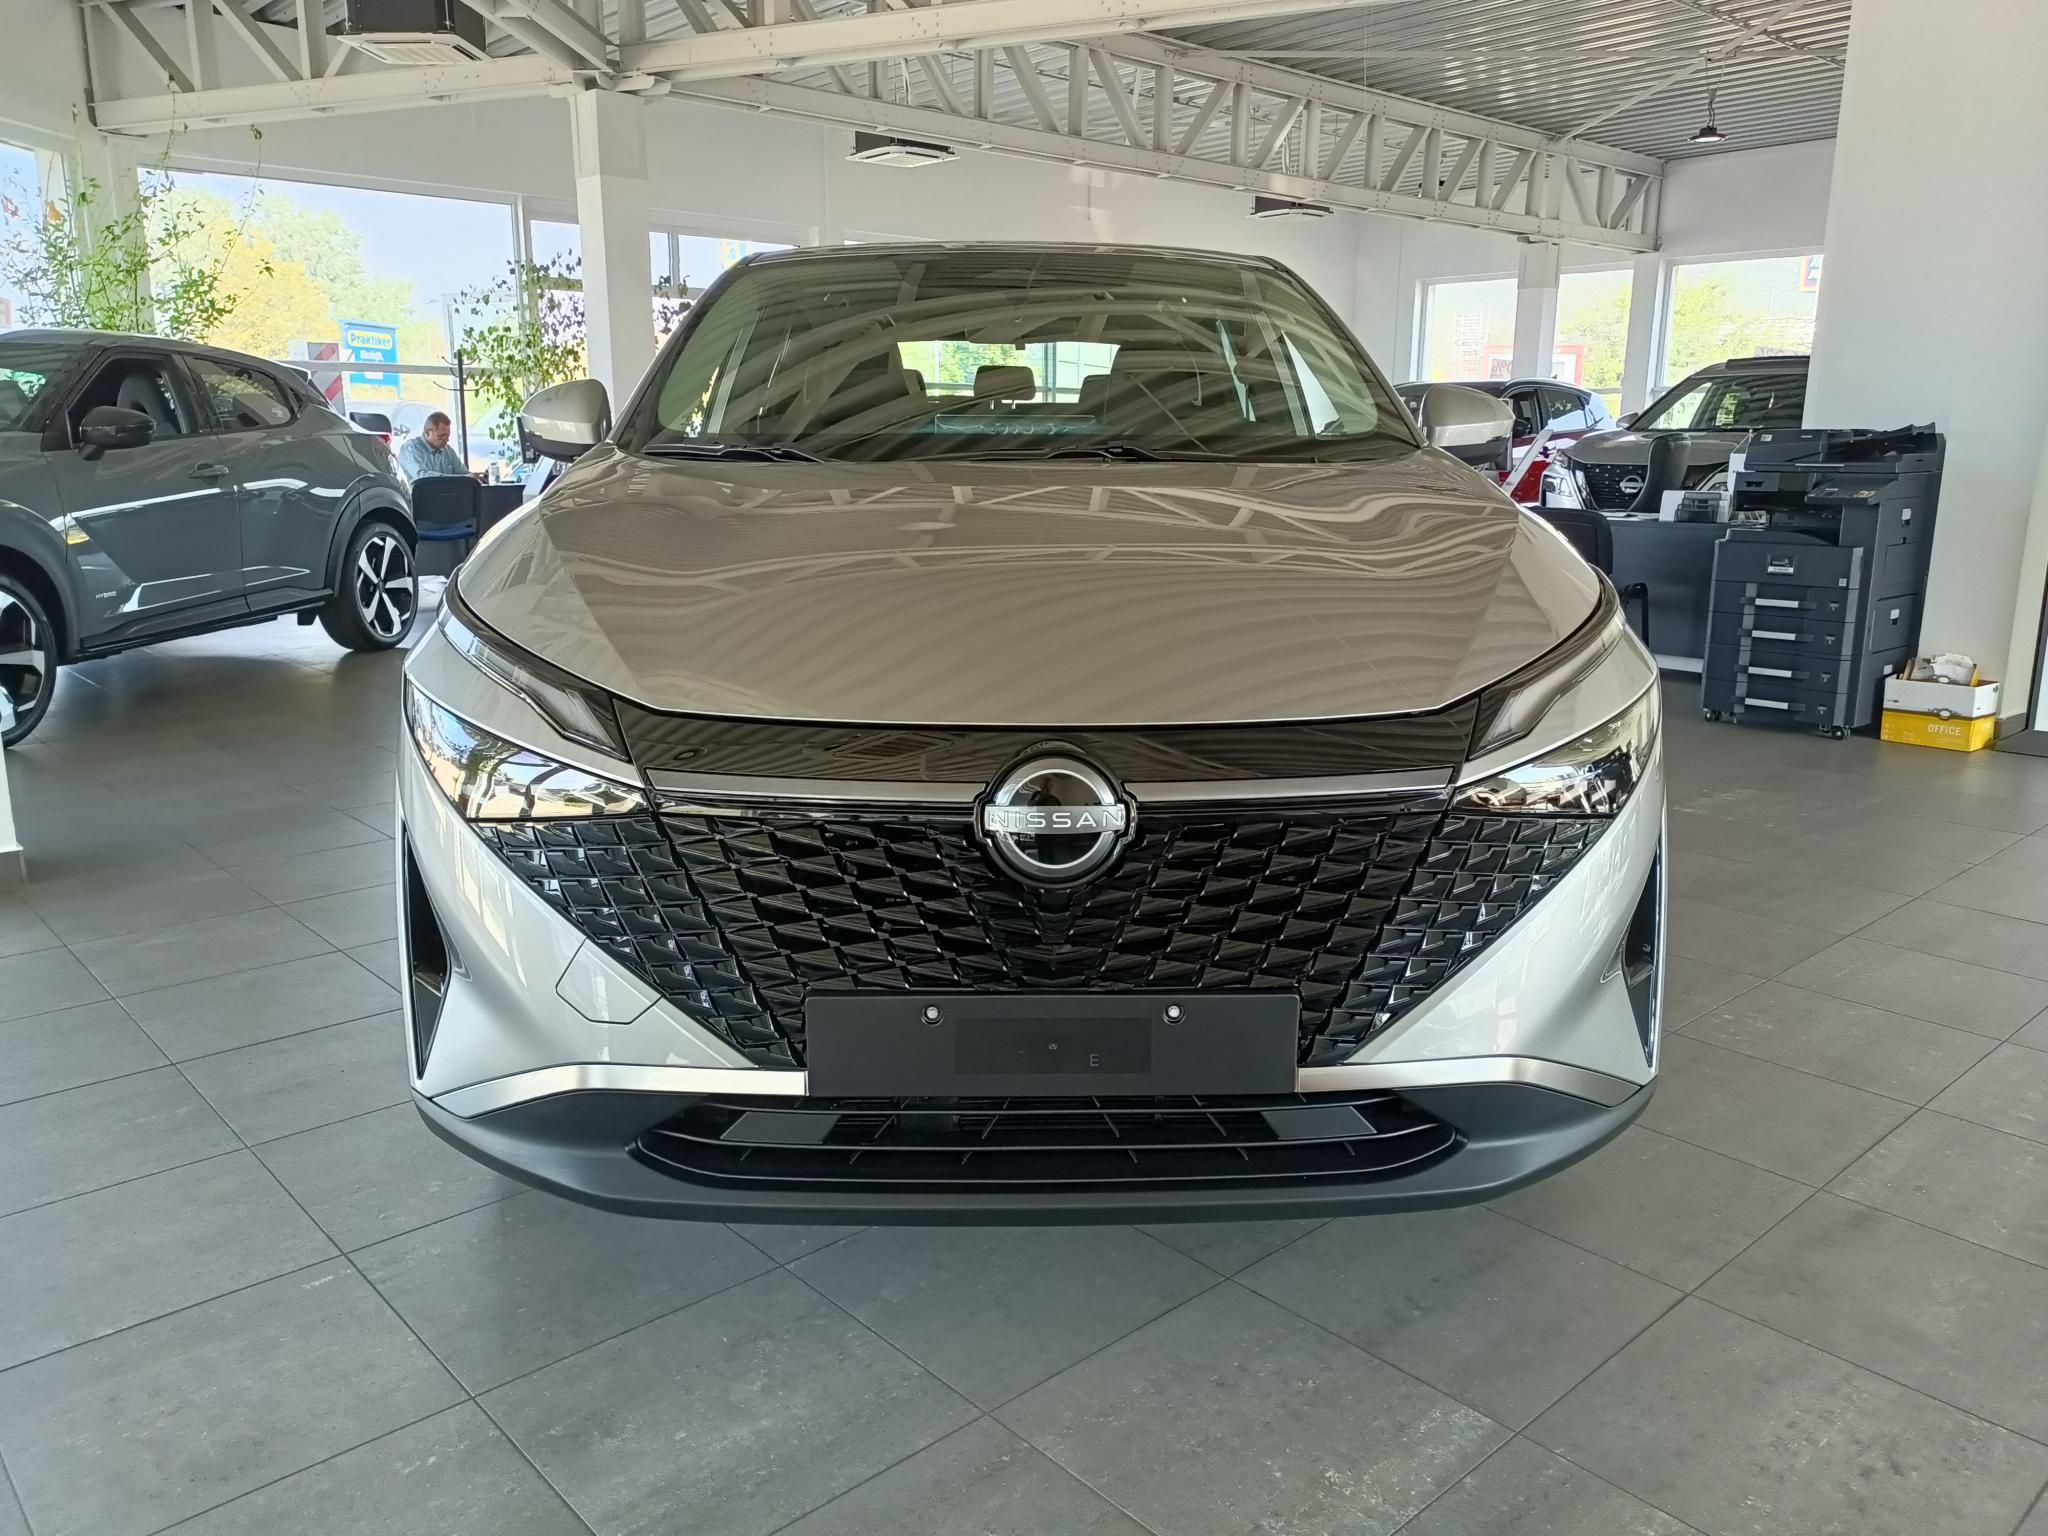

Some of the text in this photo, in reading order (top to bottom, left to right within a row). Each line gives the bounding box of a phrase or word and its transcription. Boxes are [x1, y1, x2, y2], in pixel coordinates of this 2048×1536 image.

[96, 591, 116, 600] HYBRID
[1928, 724, 1961, 736] OFFICE
[989, 810, 1123, 829] NISSAN
[1089, 1053, 1099, 1066] E
